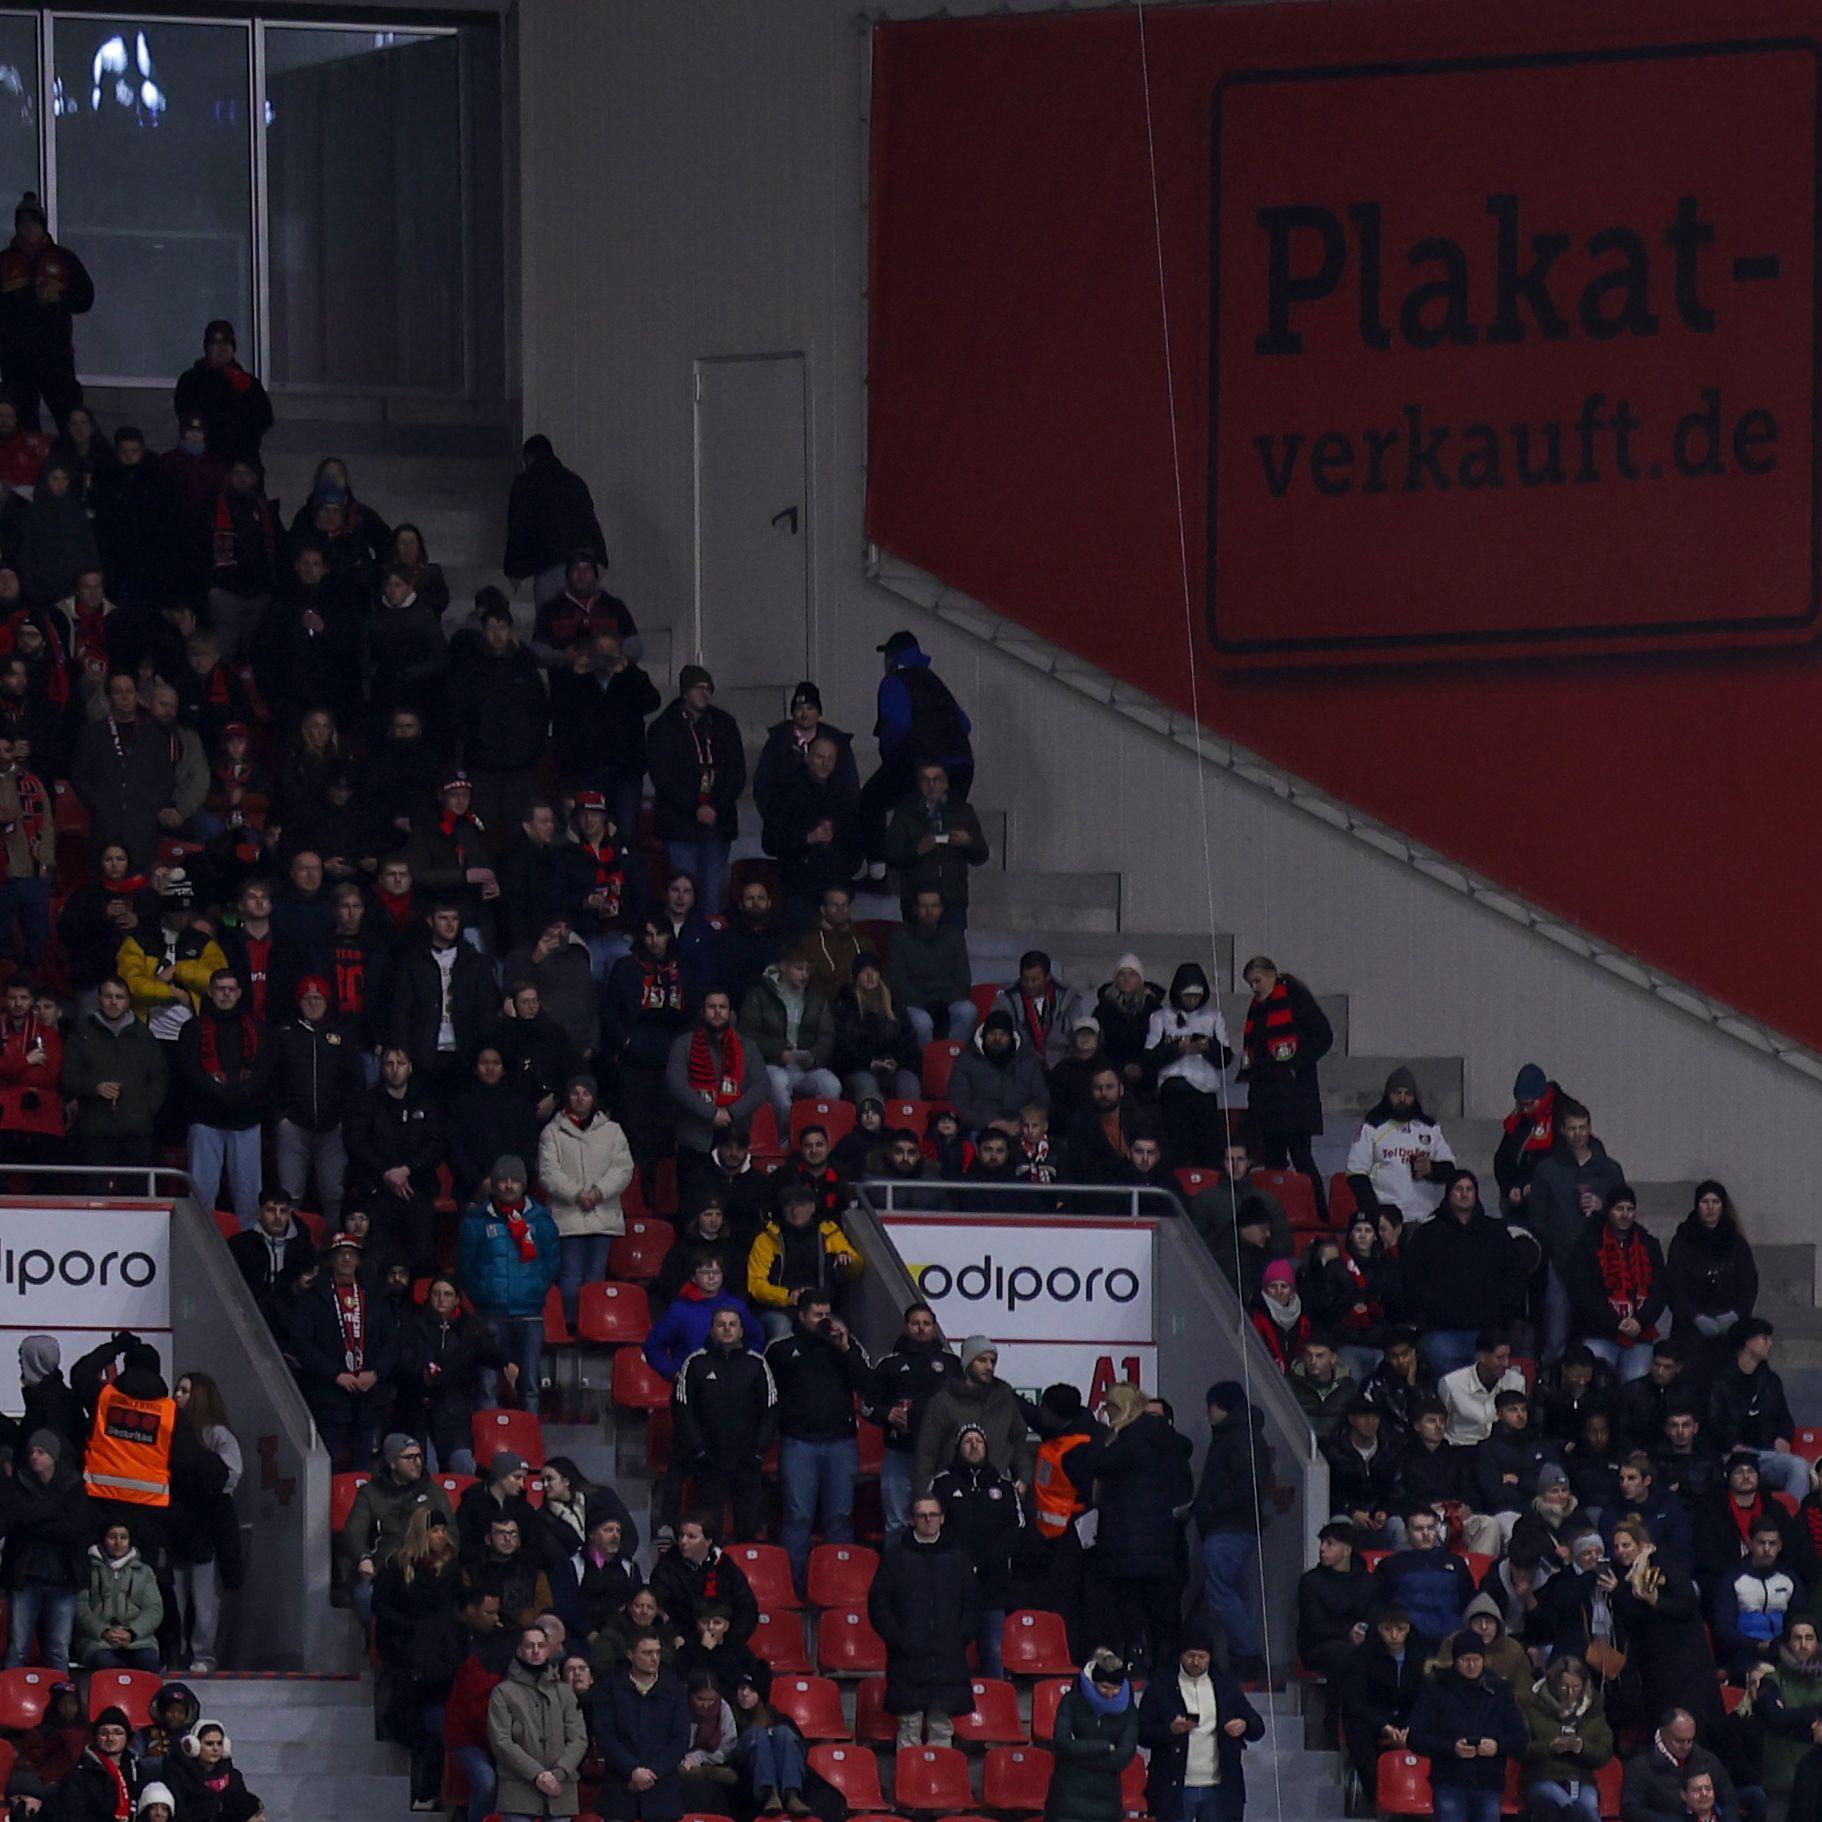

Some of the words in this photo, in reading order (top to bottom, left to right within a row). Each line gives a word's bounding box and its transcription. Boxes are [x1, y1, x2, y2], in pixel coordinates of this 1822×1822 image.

[1253, 193, 1781, 357] Plakat-
[1253, 387, 1780, 499] verkauft.de
[5, 1248, 157, 1296] iporo
[917, 1254, 1140, 1312] odiporo
[1090, 1355, 1142, 1409] A1
